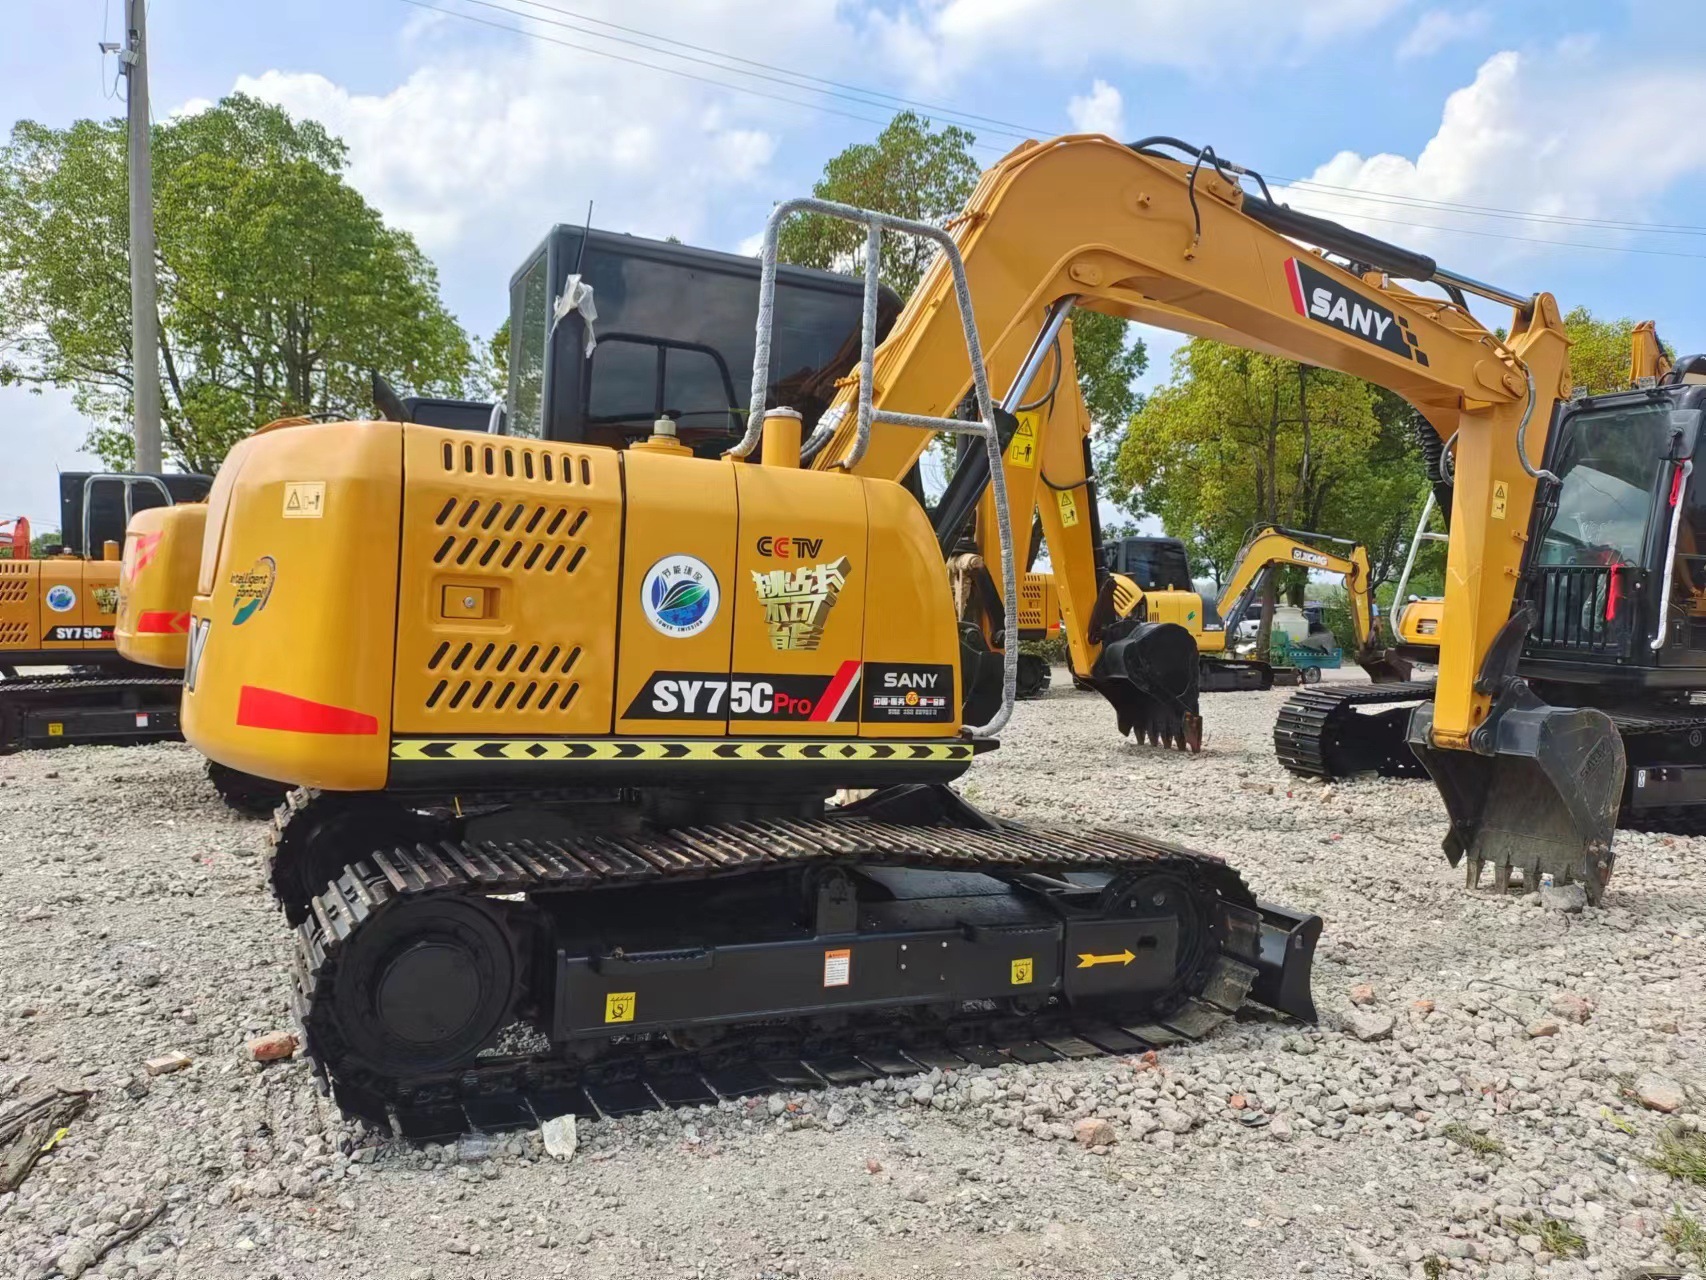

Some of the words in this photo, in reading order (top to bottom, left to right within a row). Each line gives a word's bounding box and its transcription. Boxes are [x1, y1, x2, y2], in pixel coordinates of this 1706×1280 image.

[1310, 287, 1393, 341] SANY
[757, 536, 823, 559] CCTV
[883, 672, 938, 688] SANY
